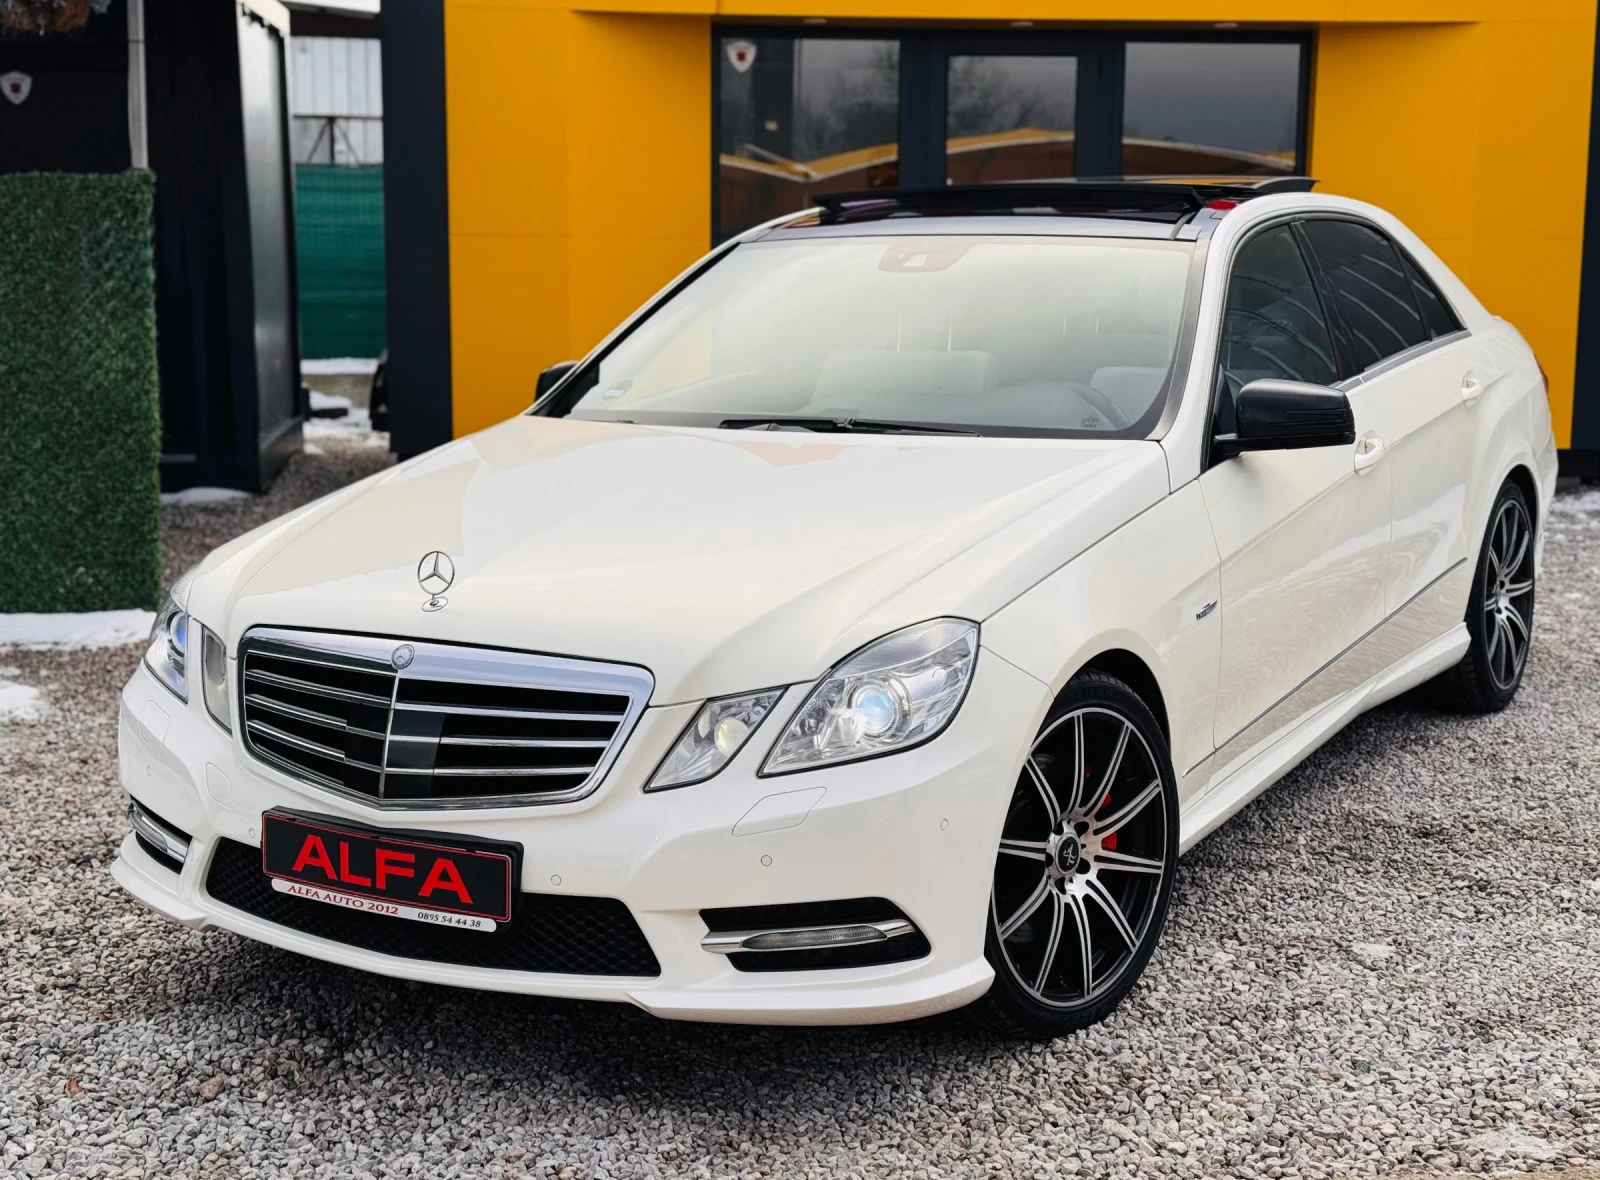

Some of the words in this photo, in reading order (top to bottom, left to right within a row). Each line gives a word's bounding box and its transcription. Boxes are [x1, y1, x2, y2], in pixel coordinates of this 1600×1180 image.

[292, 834, 473, 904] ALFA
[287, 885, 320, 898] ALFA
[324, 893, 364, 908] AUTO
[367, 902, 399, 915] 2012
[417, 911, 439, 921] 0895
[441, 915, 453, 924] 54
[455, 918, 467, 926] 44
[469, 919, 482, 928] 38
